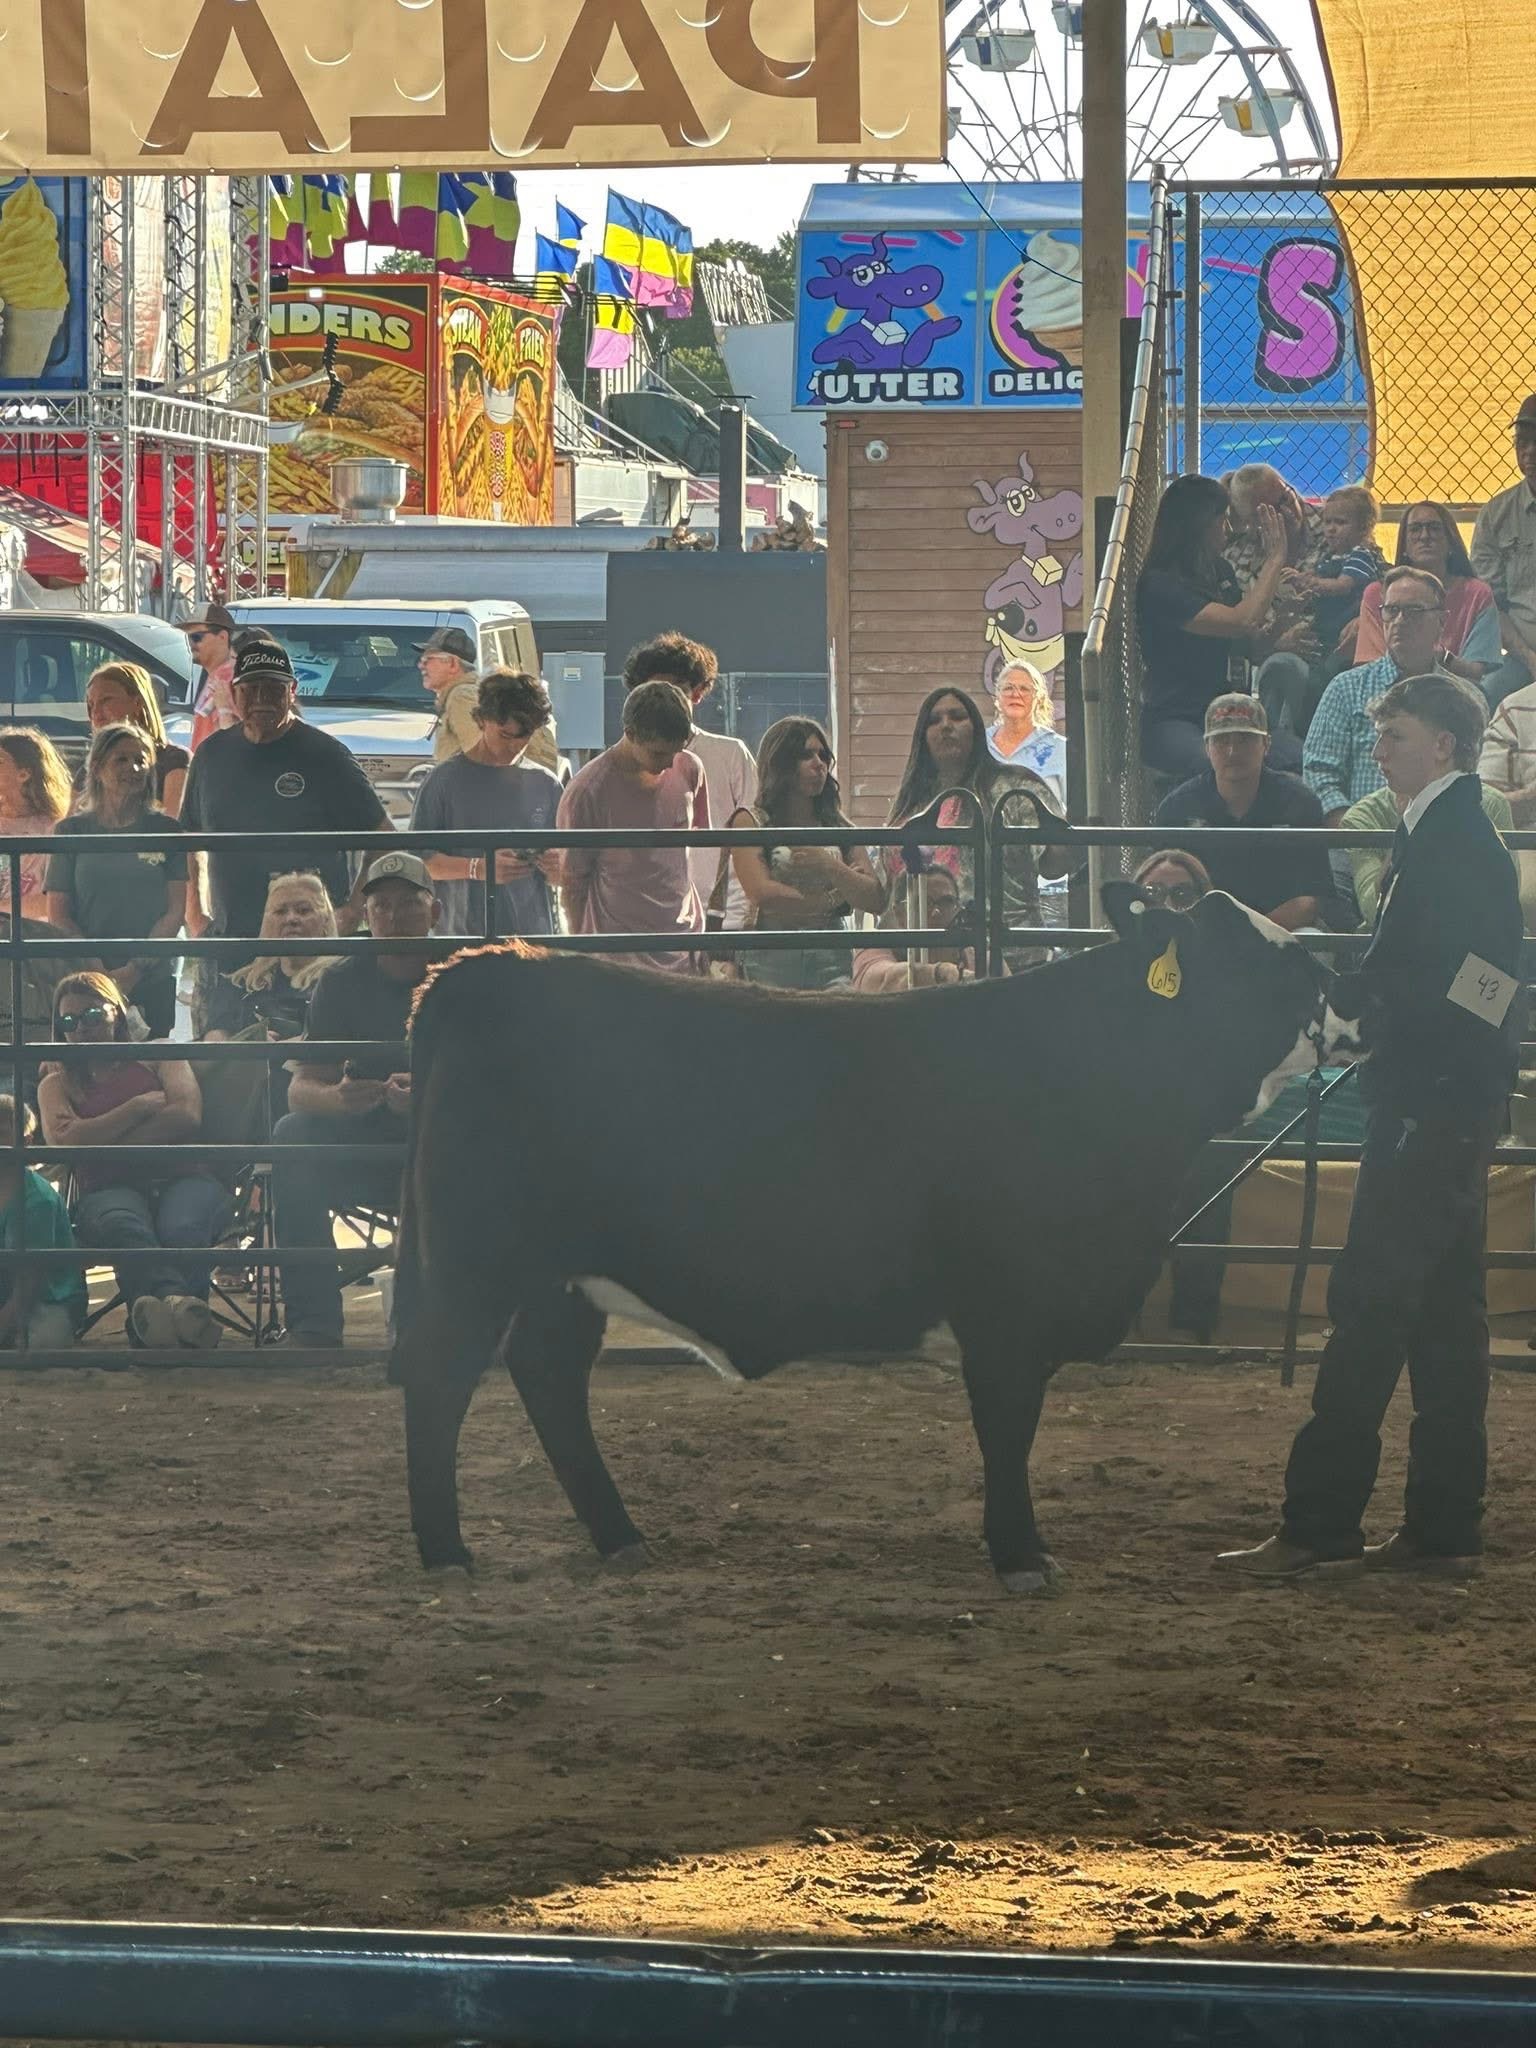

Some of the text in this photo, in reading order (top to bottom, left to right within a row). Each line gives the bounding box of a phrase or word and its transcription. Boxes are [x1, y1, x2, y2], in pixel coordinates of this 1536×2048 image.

[1258, 239, 1342, 388] S
[823, 372, 960, 399] UTTER
[1478, 973, 1500, 1001] 43
